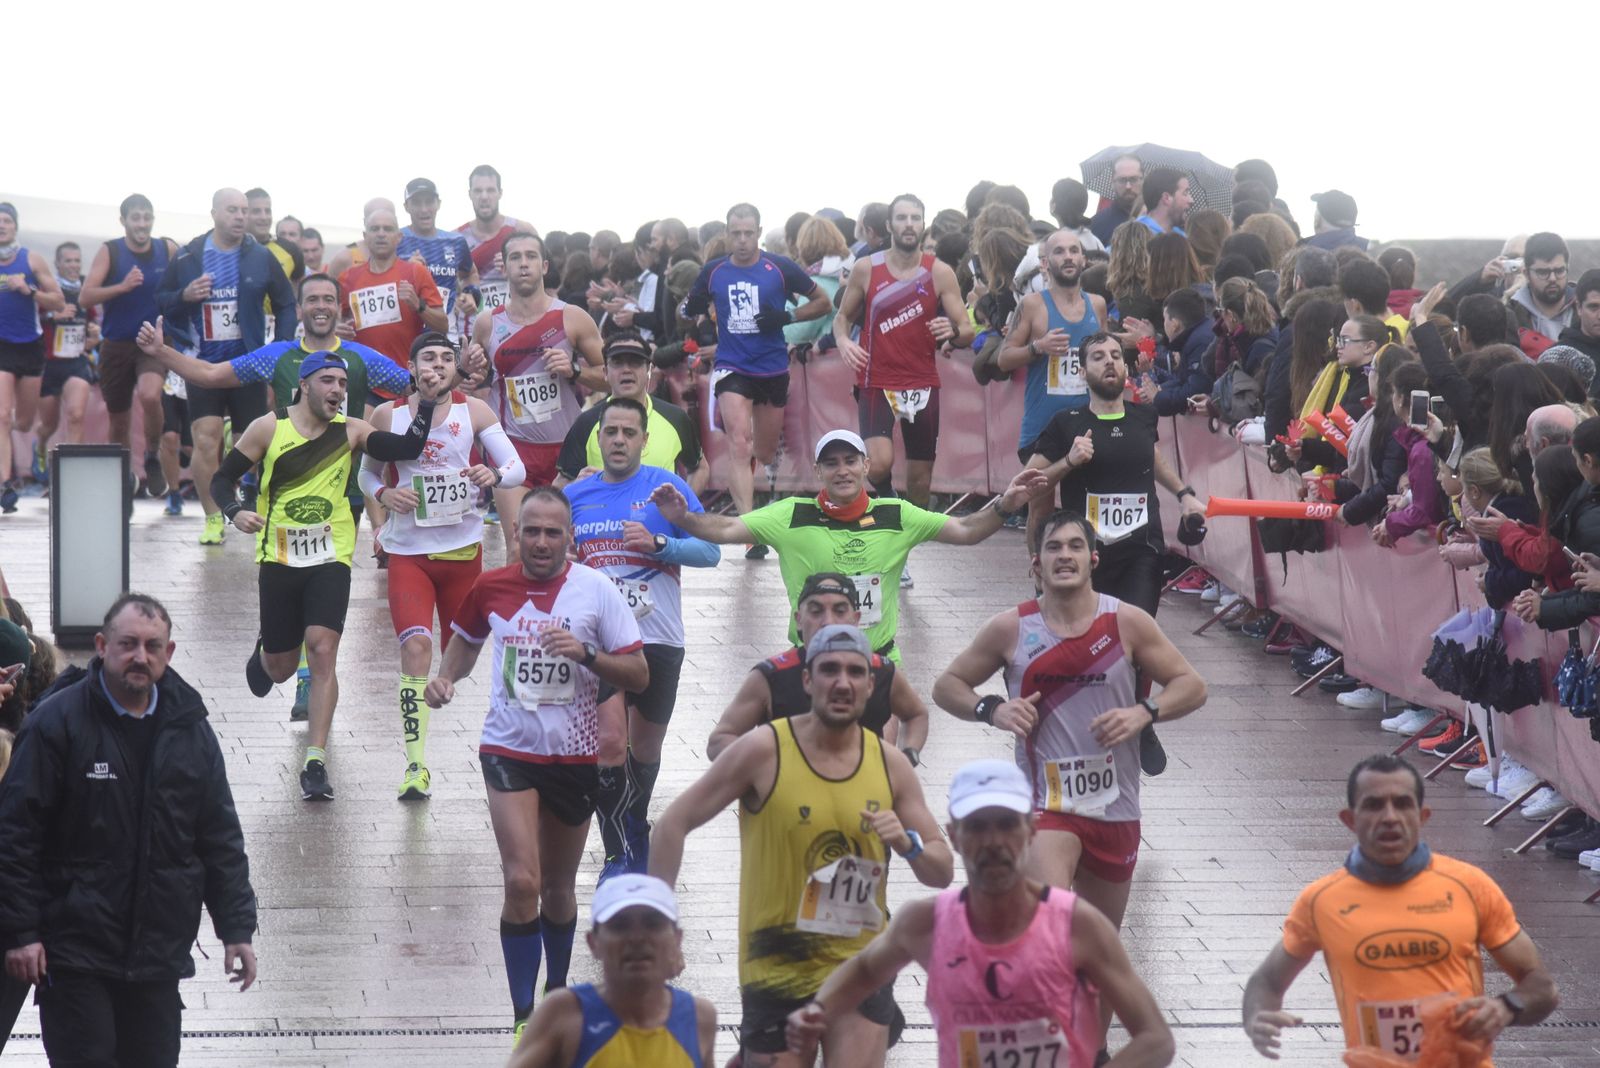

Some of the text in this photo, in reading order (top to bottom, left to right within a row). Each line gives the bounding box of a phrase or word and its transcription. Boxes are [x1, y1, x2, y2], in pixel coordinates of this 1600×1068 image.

[360, 295, 395, 314] 1876
[879, 303, 923, 335] Blanes
[518, 383, 558, 405] 1089
[426, 482, 468, 504] 2733
[1101, 507, 1143, 527] 1067
[1305, 503, 1332, 519] edp
[291, 535, 328, 556] 1111
[518, 663, 570, 684] 5579
[1064, 768, 1113, 798] 1090
[1364, 941, 1440, 961] GALBIS
